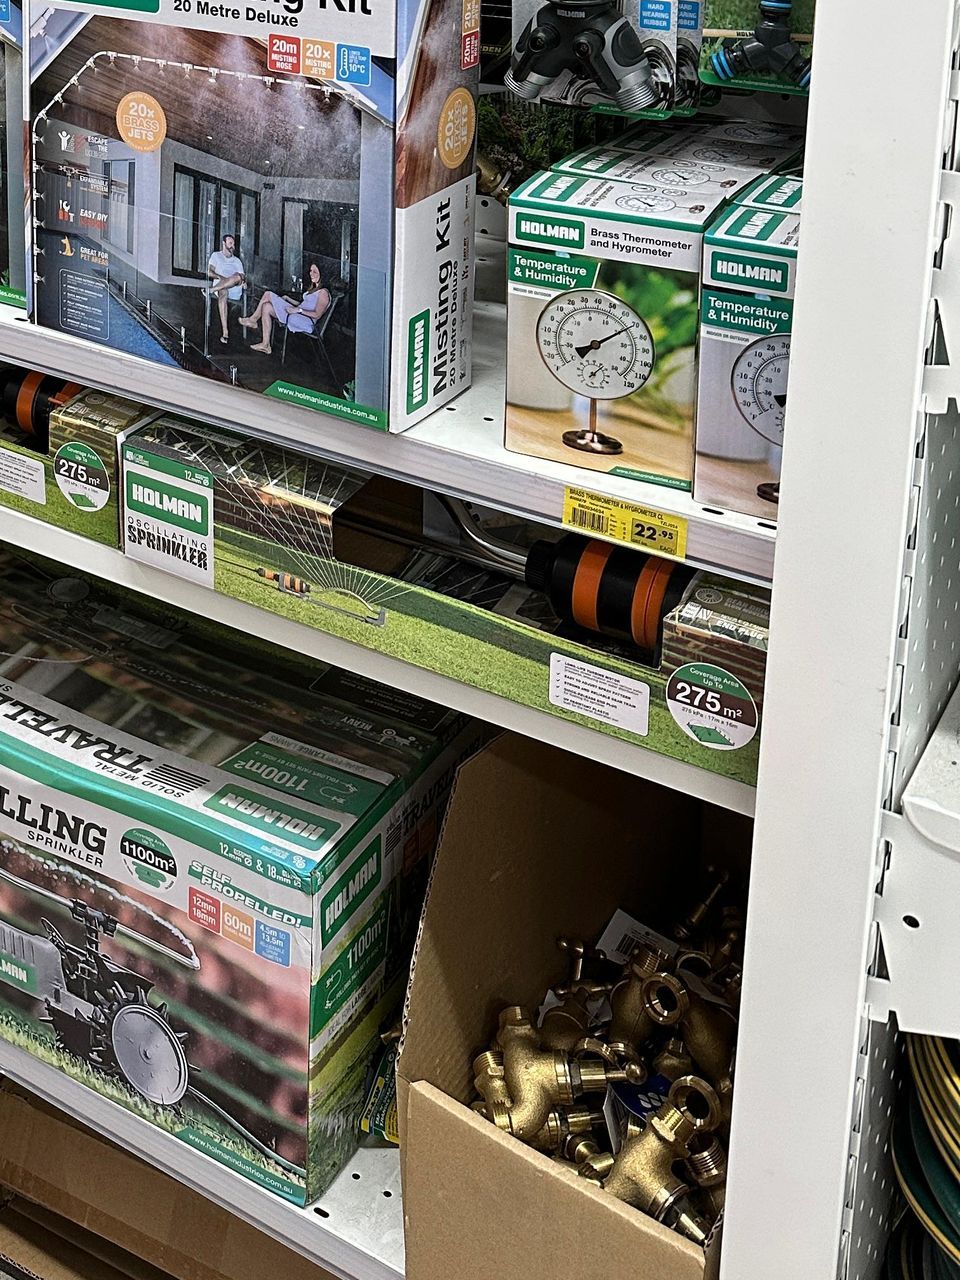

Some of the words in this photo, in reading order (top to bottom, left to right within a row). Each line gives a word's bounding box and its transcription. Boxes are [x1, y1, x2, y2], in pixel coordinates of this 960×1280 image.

[173, 0, 192, 14] 20
[196, 0, 240, 20] Metre
[245, 6, 298, 28] Deluxe
[272, 39, 298, 54] 20m
[128, 101, 155, 118] 20x
[122, 116, 160, 133] BRASS
[127, 128, 155, 142] JETS
[434, 196, 453, 253] Kit
[520, 220, 580, 241] HOLMAN
[590, 229, 620, 242] Brass
[623, 232, 692, 250] Thermometer
[590, 239, 609, 249] and
[612, 241, 673, 259] Hygrometer
[514, 254, 587, 277] Temperature
[514, 266, 522, 276] &
[525, 267, 577, 288] Humidity
[716, 260, 782, 283] HOLMAN
[708, 295, 789, 321] Temperature
[433, 258, 453, 397] Misting
[277, 386, 378, 422] www.holmanindustries.com.au
[58, 459, 87, 482] 275
[132, 482, 202, 523] HOLMAN
[128, 516, 208, 551] OSCILLATING
[634, 523, 674, 542] 22.95
[128, 526, 208, 571] SPRINKLER
[27, 831, 104, 868] SPRINKLER
[201, 876, 302, 928] PROPELLED!
[324, 852, 378, 932] HOLMAN
